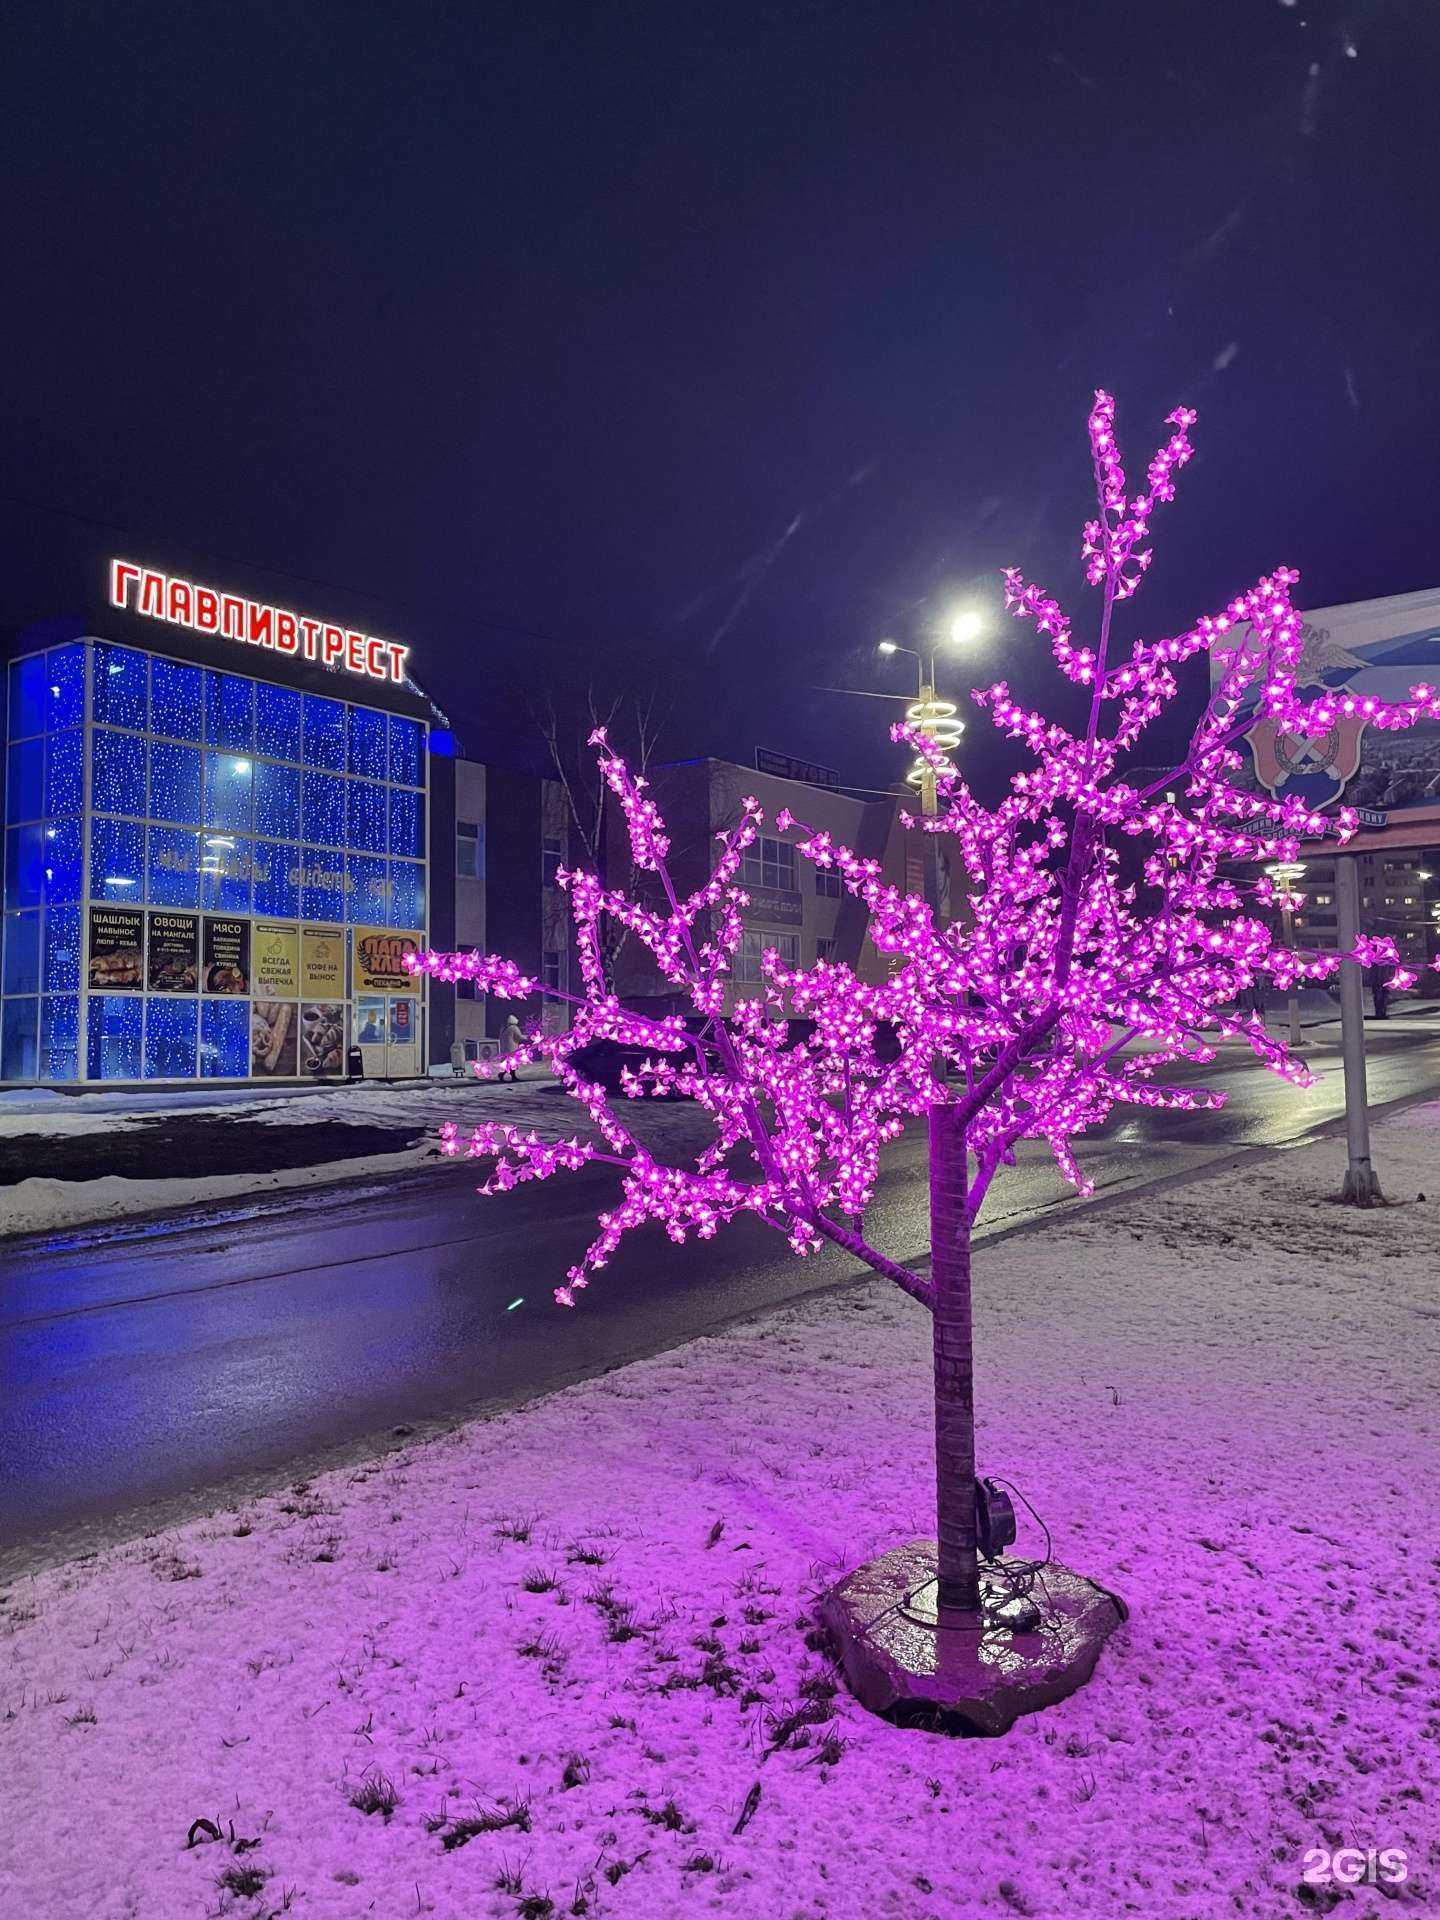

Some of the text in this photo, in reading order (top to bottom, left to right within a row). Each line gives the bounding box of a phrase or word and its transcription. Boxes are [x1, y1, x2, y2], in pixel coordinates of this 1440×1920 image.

[110, 558, 409, 684] ГЛАВПИВТРЕСТ
[93, 914, 141, 926] ШАШЛЫК
[154, 917, 193, 928] ОВОЩИ
[98, 927, 135, 936] НАВЫНОС
[213, 923, 241, 934] МЯСО
[163, 931, 195, 939] МАНГАЛЕ
[262, 956, 290, 966] ВСЕГДА
[260, 967, 291, 975] СВЕЖАЯ
[307, 963, 326, 971] КОФЕ
[258, 977, 294, 985] ВЫПЕЧКА
[309, 973, 335, 981] ВЫНОС
